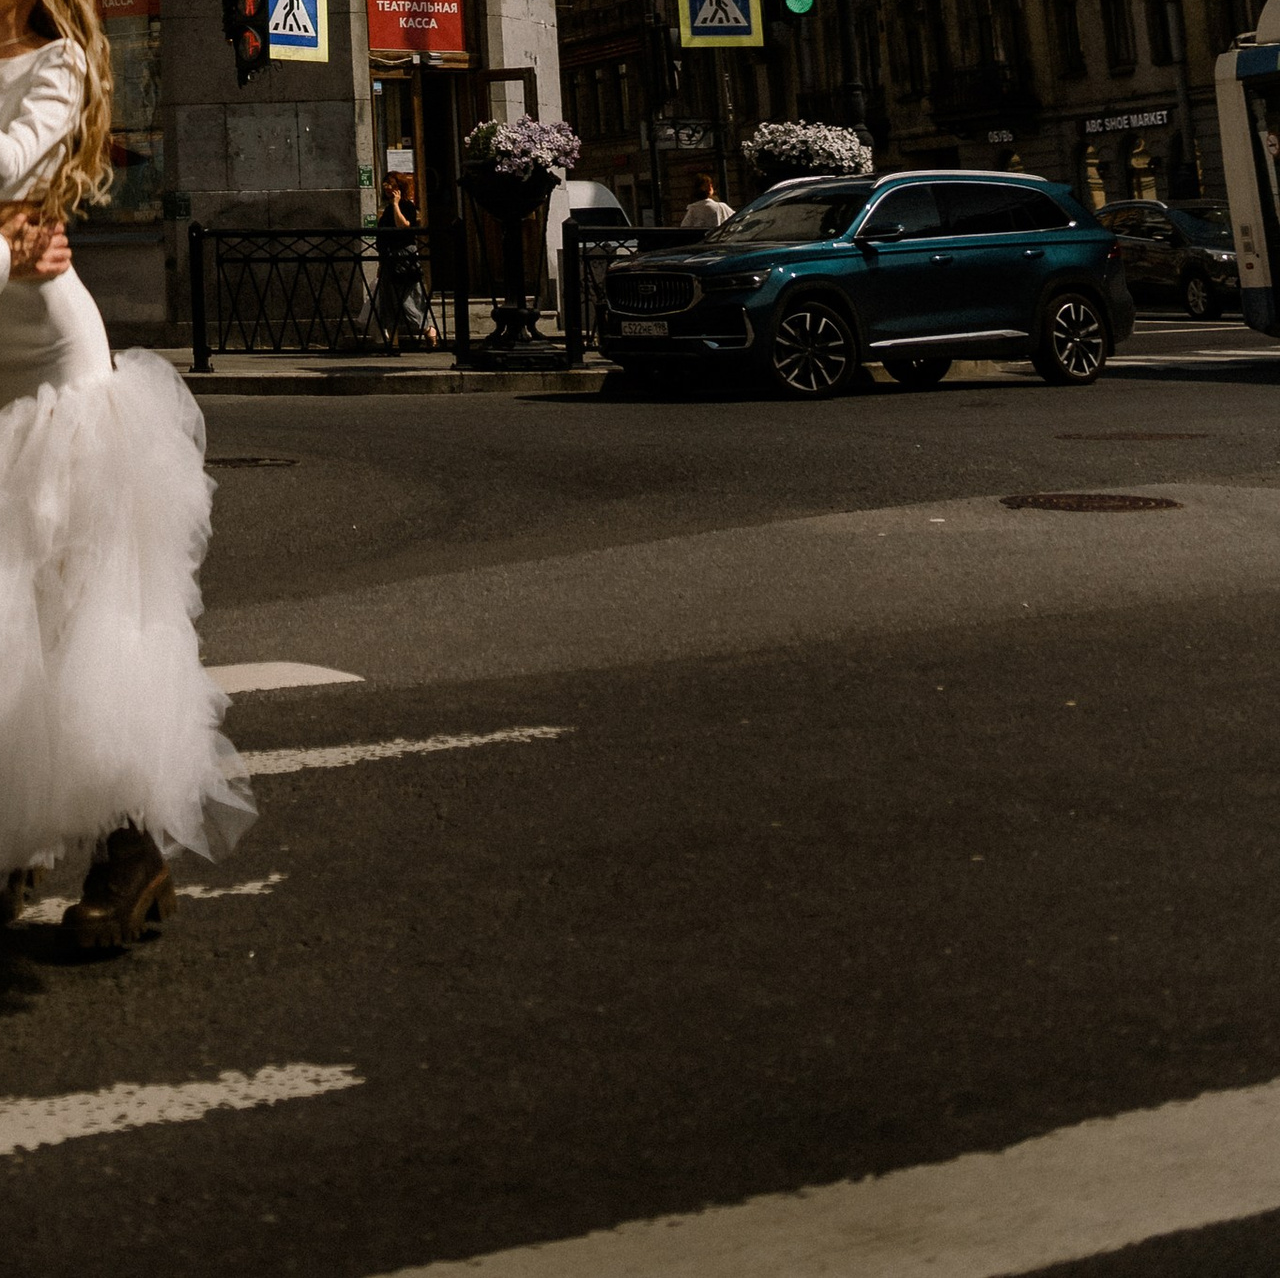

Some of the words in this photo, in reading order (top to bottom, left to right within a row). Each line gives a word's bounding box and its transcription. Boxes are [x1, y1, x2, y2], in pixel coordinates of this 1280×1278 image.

[377, 1, 458, 15] ТЕАТРАЛЬНАЯ
[399, 17, 438, 29] КАССА
[1086, 119, 1103, 133] ABC
[1104, 115, 1129, 131] SHOE
[1130, 110, 1168, 127] MARKET
